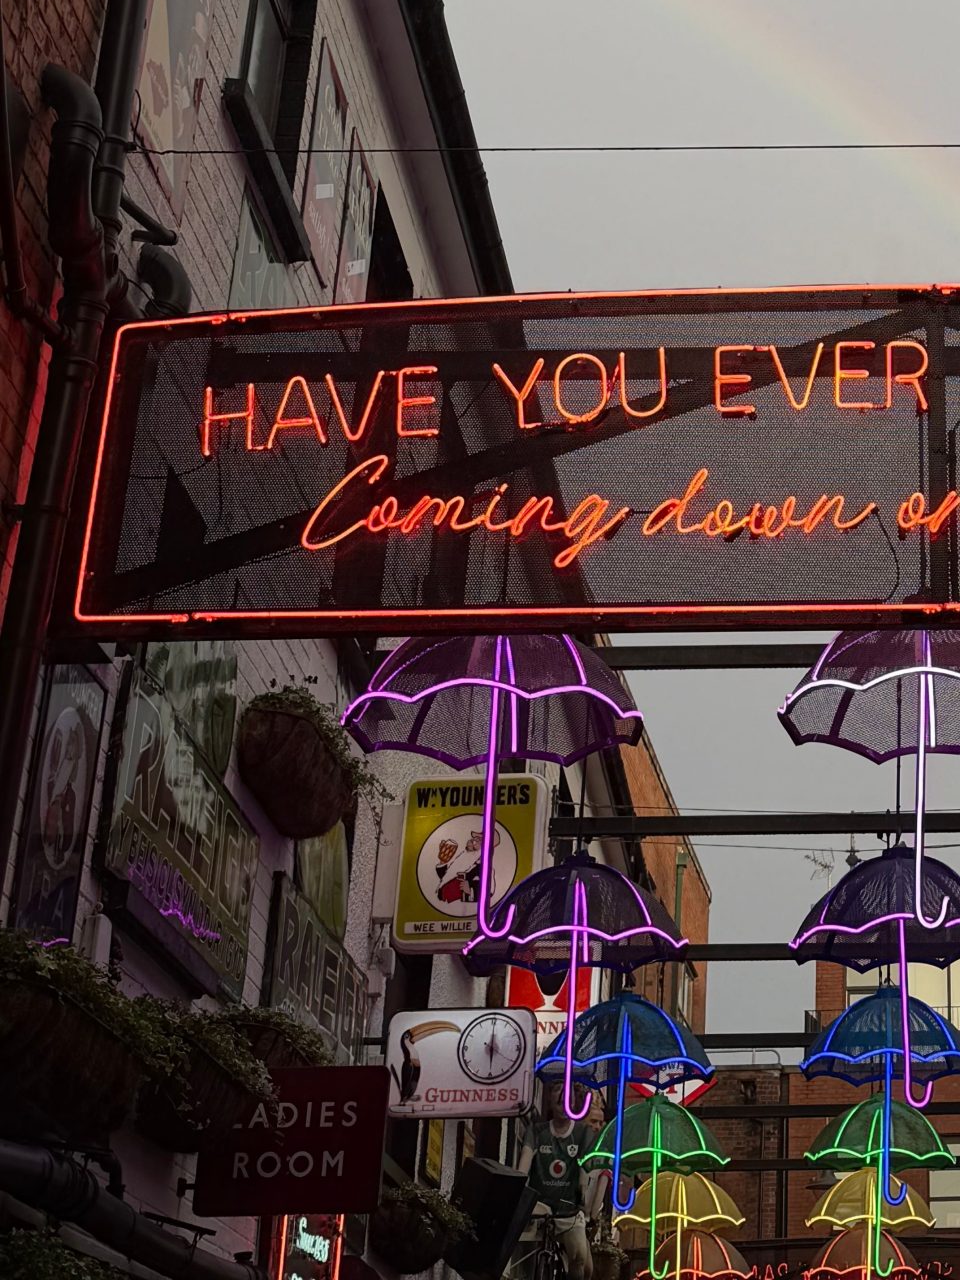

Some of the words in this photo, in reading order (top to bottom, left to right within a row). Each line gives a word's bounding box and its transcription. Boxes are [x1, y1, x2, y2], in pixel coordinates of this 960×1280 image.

[203, 366, 440, 457] HAVE
[493, 351, 667, 430] YOU
[714, 340, 930, 417] EVER
[301, 454, 630, 568] Coming
[641, 468, 878, 538] down
[439, 783, 531, 807] YOUNER'S
[413, 923, 435, 932] WEE
[441, 922, 472, 932] WILLIE
[425, 1087, 519, 1103] GUINNESS
[232, 1101, 359, 1129] ADIES
[232, 1150, 345, 1180] ROOM
